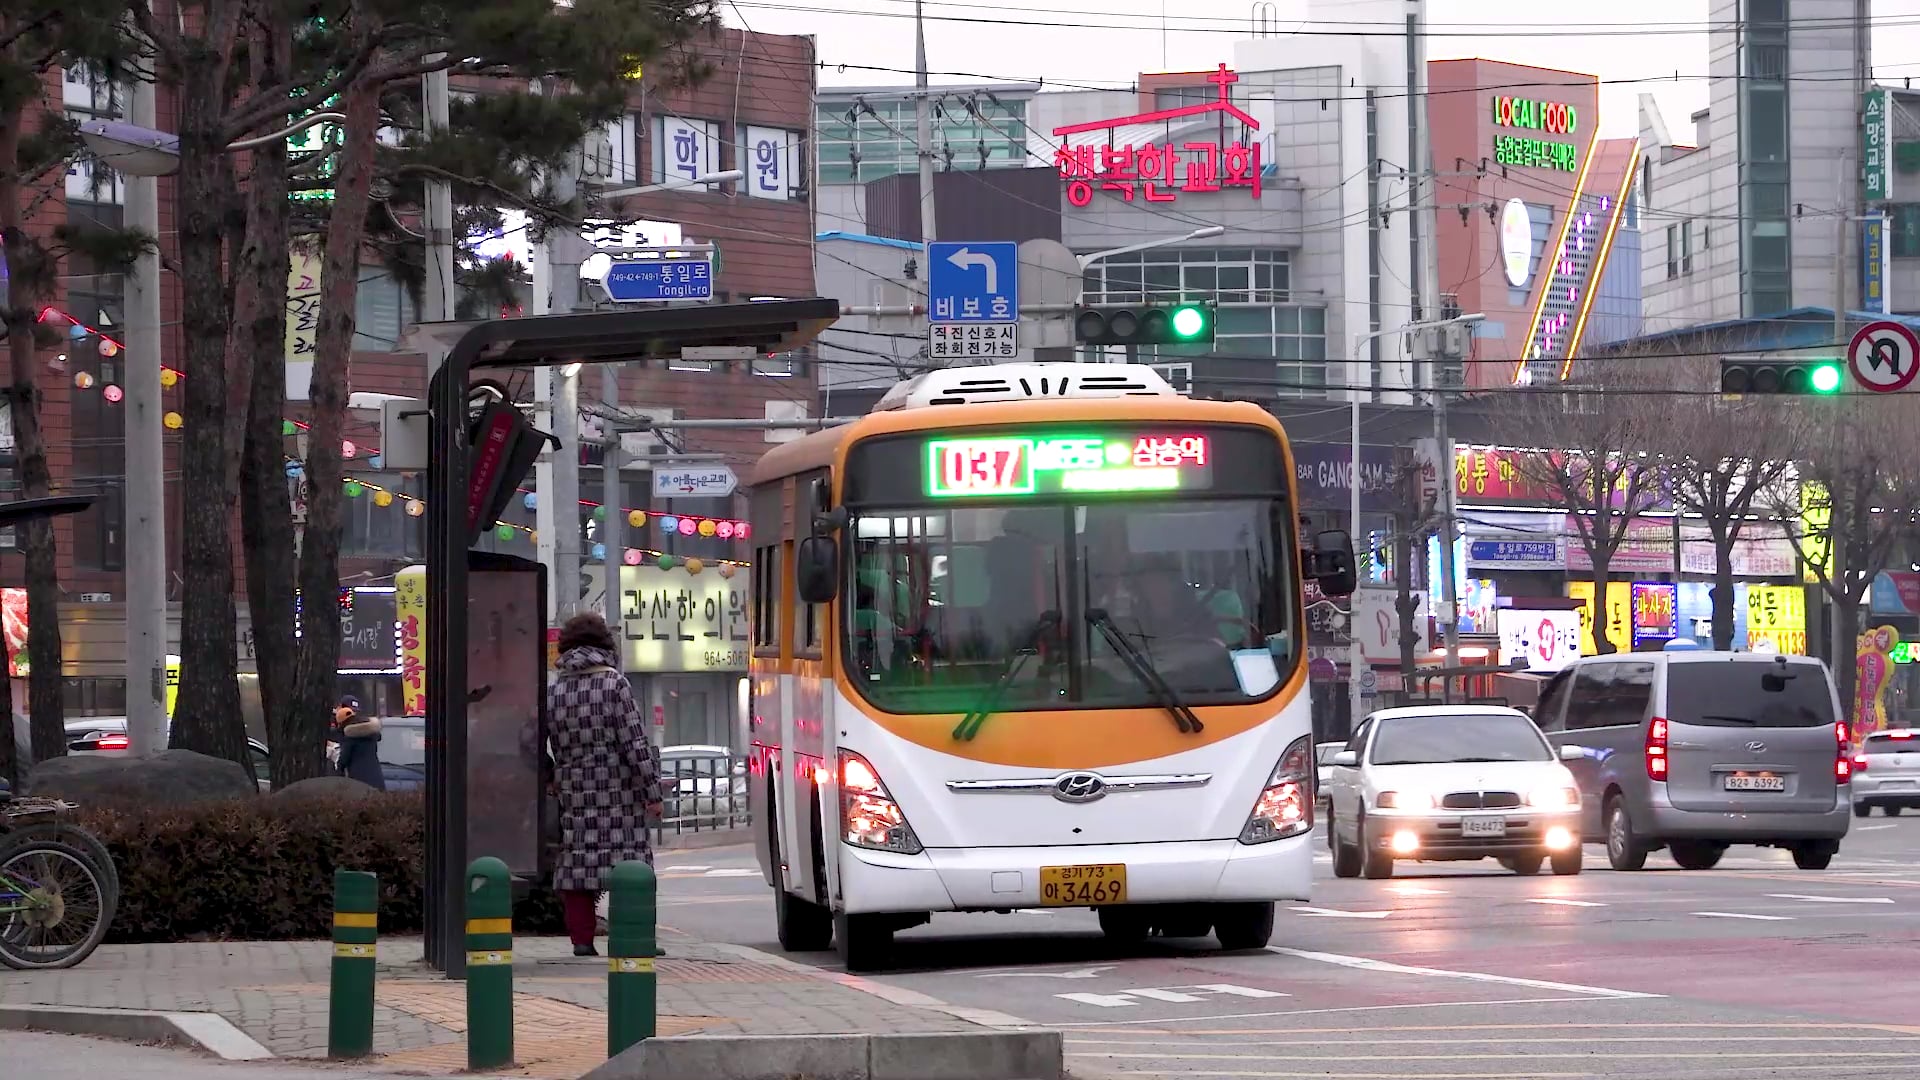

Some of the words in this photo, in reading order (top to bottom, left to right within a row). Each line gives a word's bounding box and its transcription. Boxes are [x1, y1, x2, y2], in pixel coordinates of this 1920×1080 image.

[1494, 95, 1537, 129] LOCAL
[1539, 101, 1577, 134] FOOD
[1866, 98, 1881, 192] 소망교회
[1054, 141, 1262, 207] 행복한교회
[660, 264, 709, 284] 통일로
[657, 284, 709, 298] Tongil-ro
[936, 295, 1011, 320] 비보호
[1132, 436, 1206, 467] 삼송역
[673, 473, 727, 489] 아름다운교회
[944, 446, 1020, 490] 037
[623, 588, 749, 641] 관산한의원
[1636, 592, 1672, 622] 마사지
